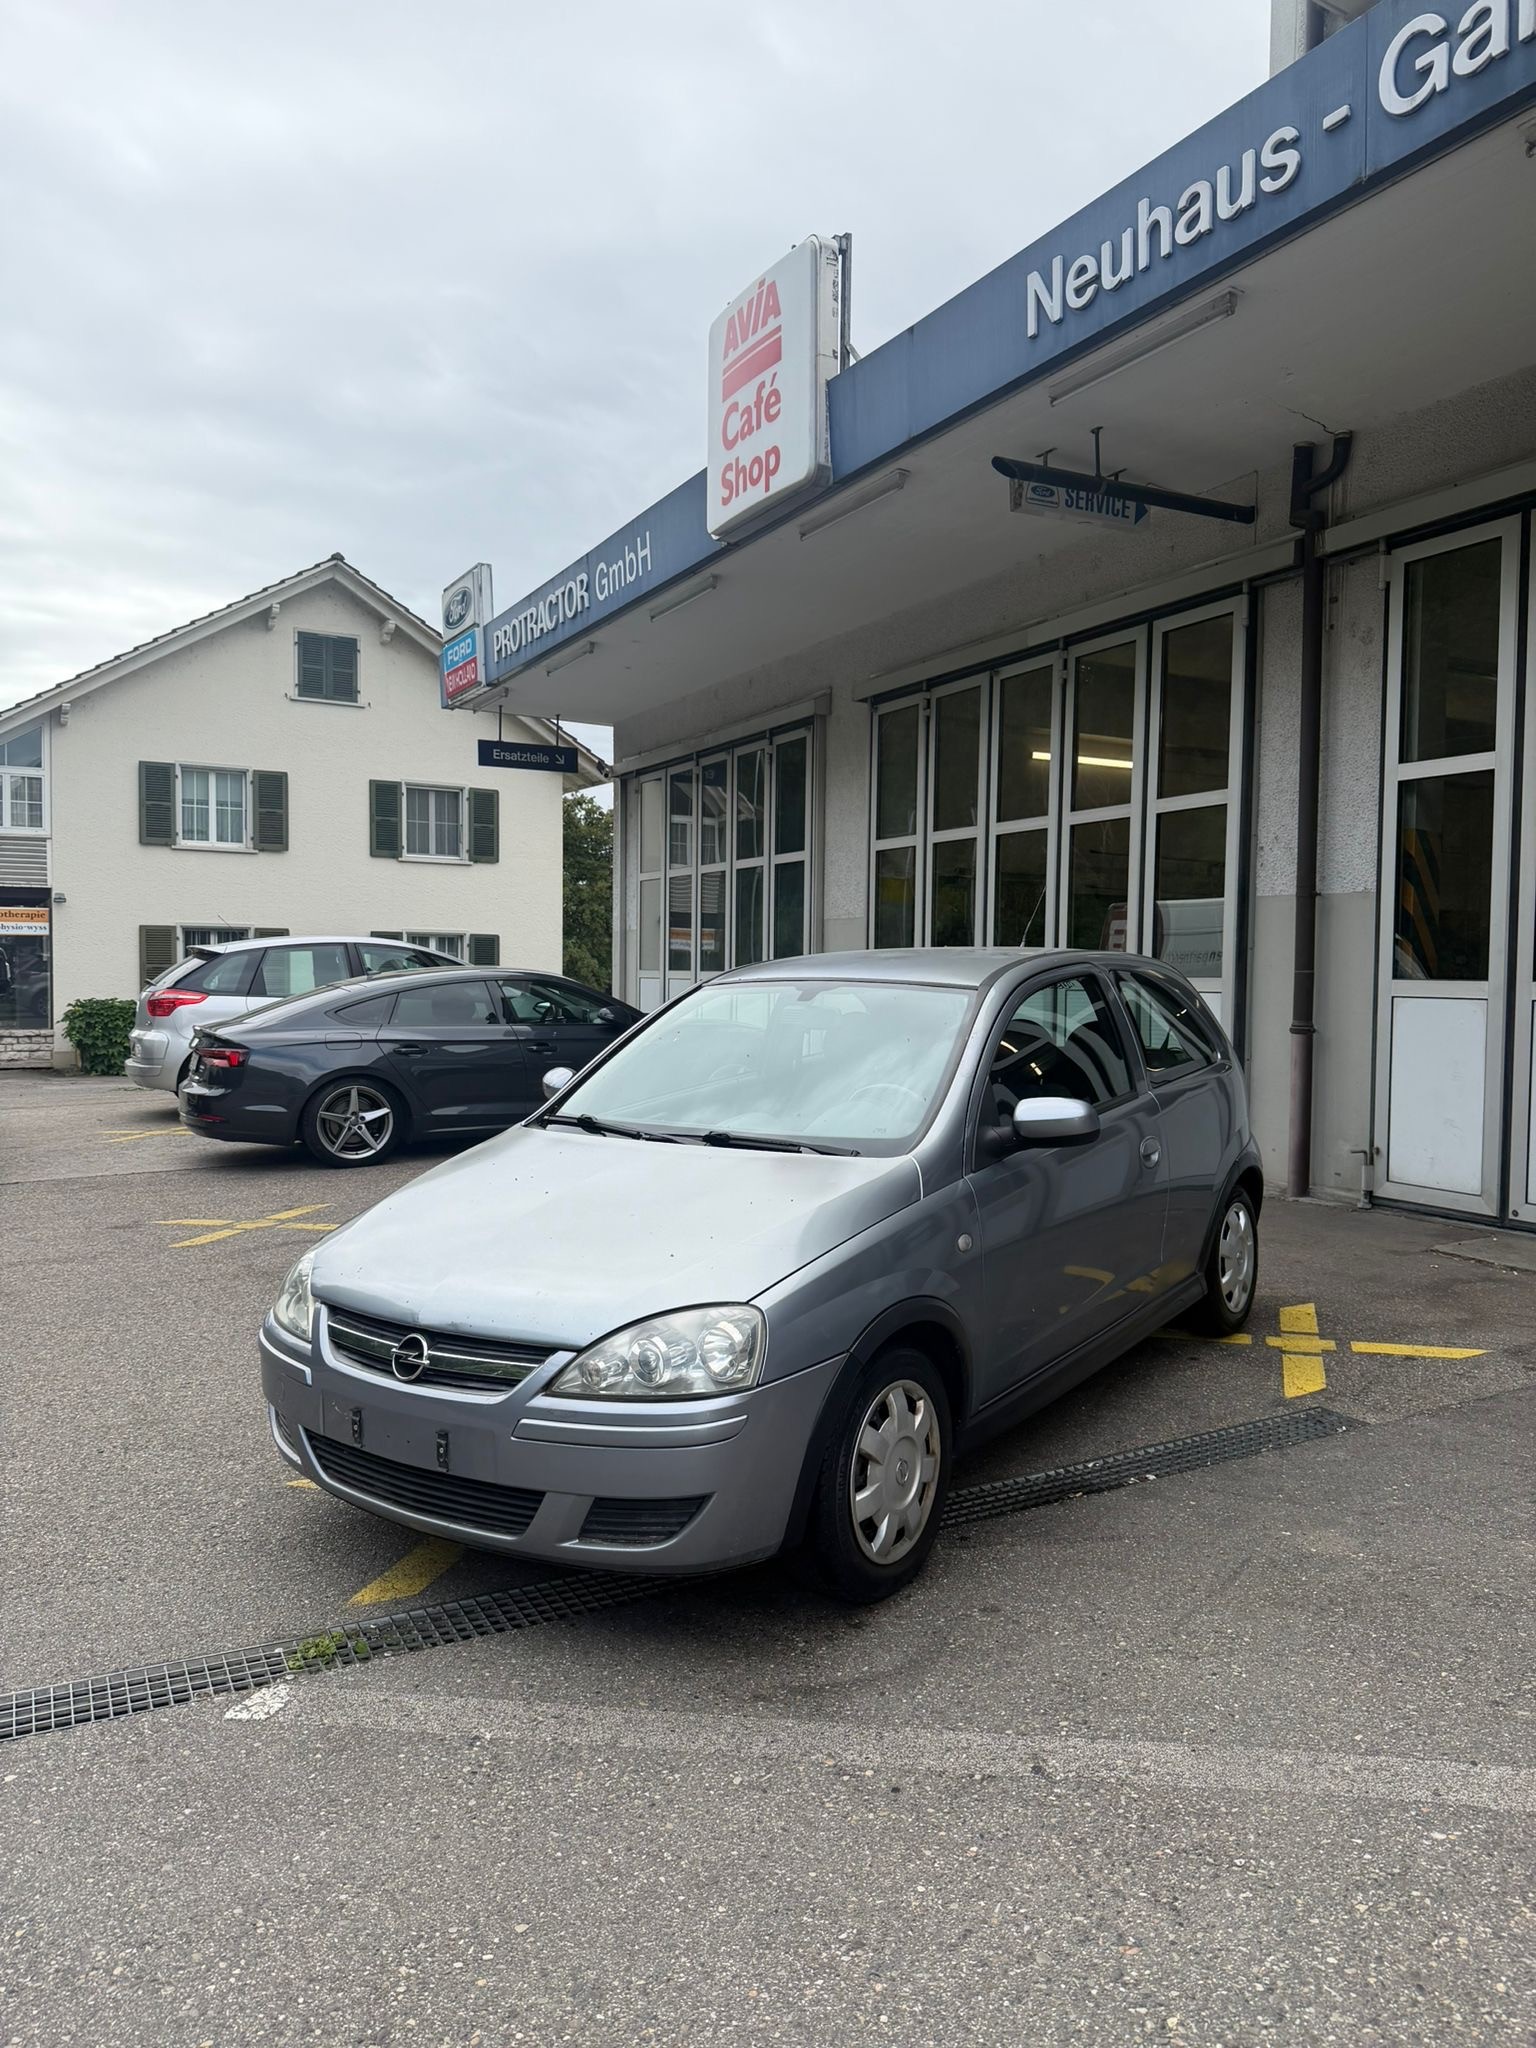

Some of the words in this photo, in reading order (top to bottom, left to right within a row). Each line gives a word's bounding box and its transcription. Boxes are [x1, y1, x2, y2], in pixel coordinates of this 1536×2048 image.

[1026, 126, 1301, 339] Neuhaus
[722, 371, 782, 451] Café
[721, 445, 781, 507] Shop
[1064, 488, 1131, 519] SERVICE
[447, 590, 469, 624] Ford
[493, 572, 591, 664] PROTRACTOR
[595, 531, 652, 601] GmbH
[447, 637, 472, 665] FORD
[492, 748, 550, 764] Ersatzteile
[0, 923, 48, 933] hysio-wyss
